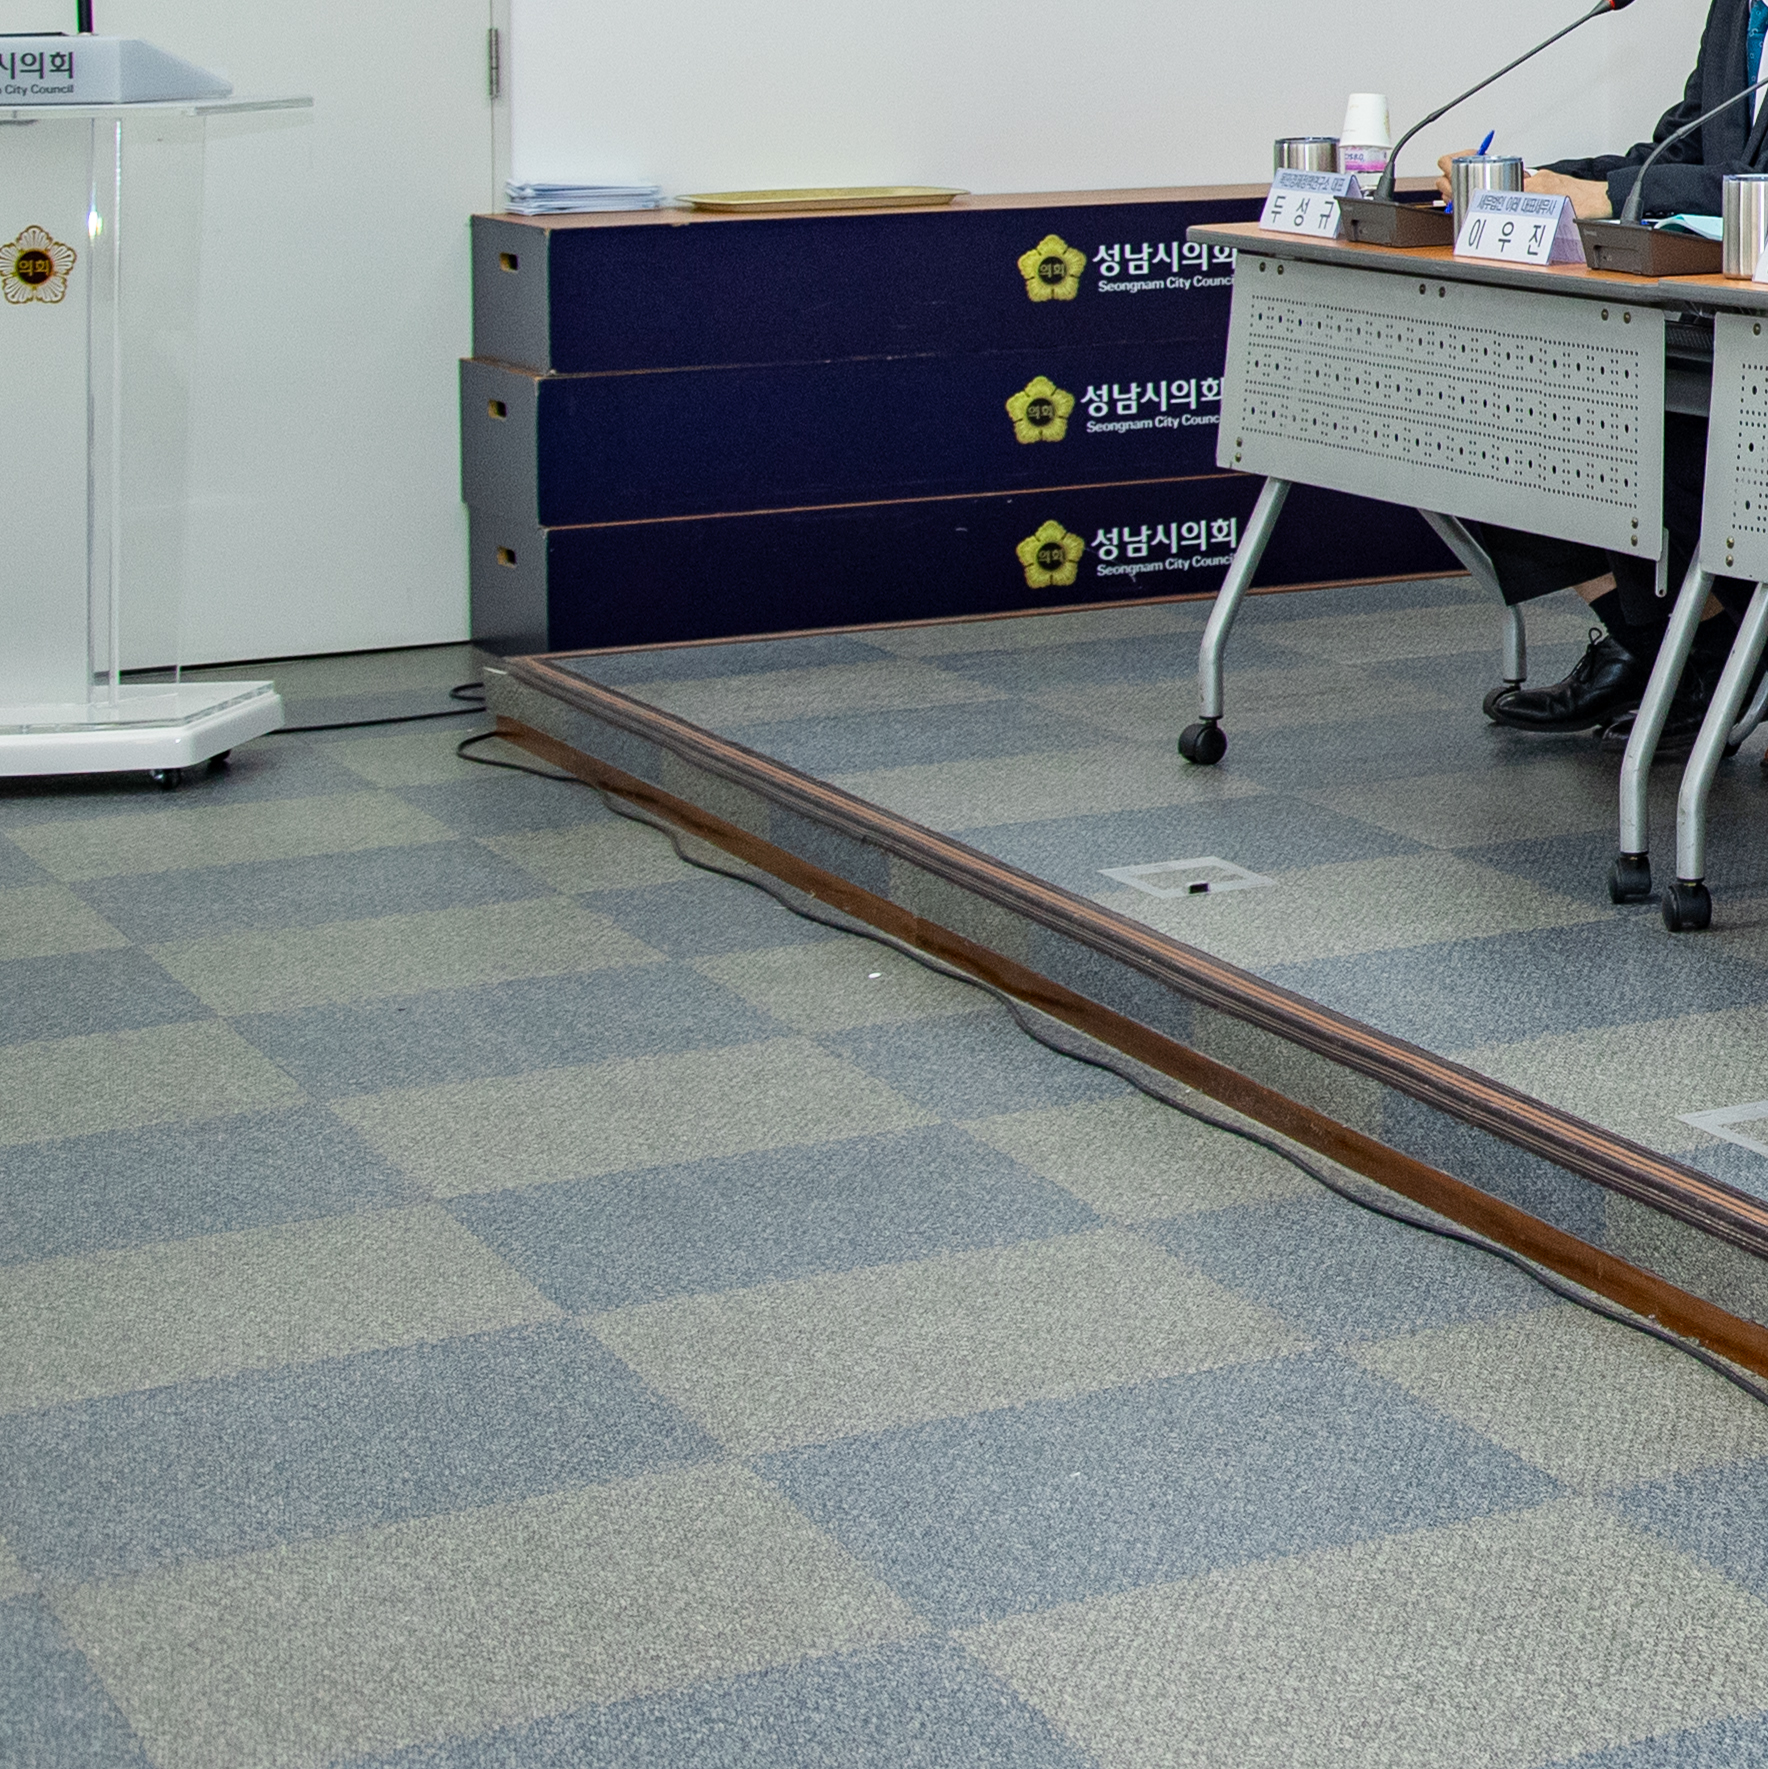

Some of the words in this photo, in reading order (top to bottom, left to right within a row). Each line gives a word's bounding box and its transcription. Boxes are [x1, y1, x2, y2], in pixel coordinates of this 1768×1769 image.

[5, 84, 27, 96] City
[31, 84, 74, 94] Council
[19, 259, 49, 276] 의회
[1098, 280, 1164, 293] Seongnam
[1166, 276, 1191, 290] City
[1193, 274, 1235, 287] Counci
[1080, 377, 1224, 417] 성남시의회
[1087, 420, 1152, 434] Seongnam
[1155, 415, 1180, 430] City
[1182, 414, 1220, 426] Counc
[1091, 517, 1237, 560] 성남시의회
[1097, 563, 1163, 577] Seongnam
[1165, 557, 1190, 571] City
[1192, 553, 1235, 567] Counci
